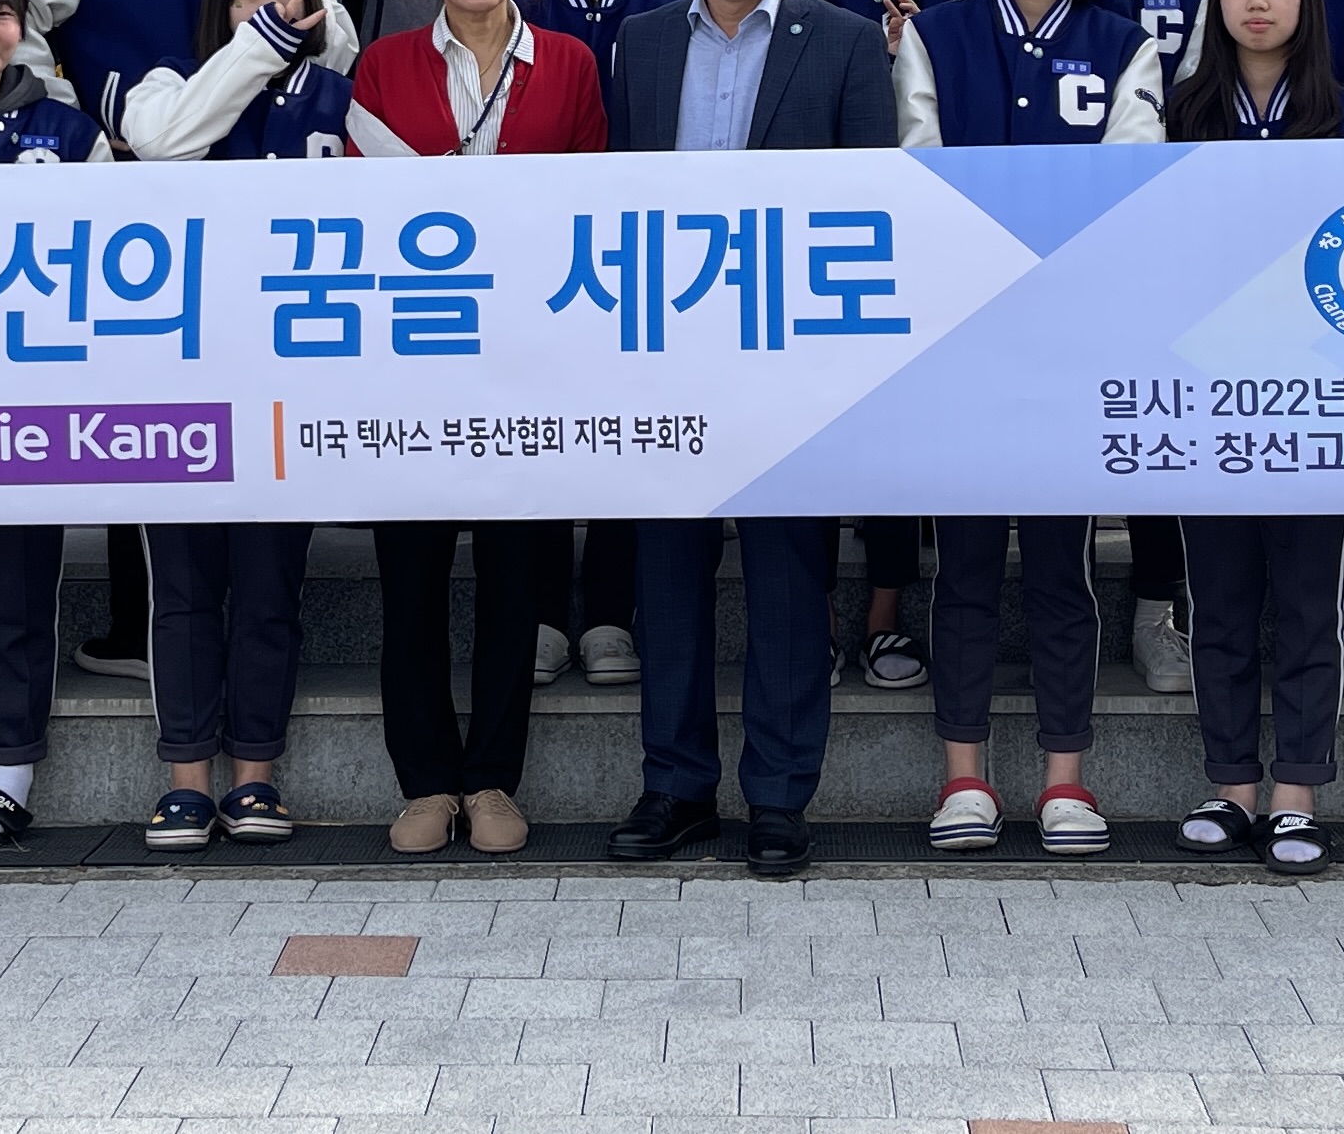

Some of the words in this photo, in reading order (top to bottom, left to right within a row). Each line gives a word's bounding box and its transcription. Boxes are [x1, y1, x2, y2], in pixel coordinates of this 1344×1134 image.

[1058, 73, 1105, 126] C
[261, 211, 494, 357] 꿈을
[545, 207, 911, 353] 세계로
[1100, 378, 1195, 419] 일시:
[69, 413, 217, 473] Kang
[299, 420, 348, 458] 미국
[357, 418, 432, 458] 텍사스
[440, 416, 564, 458] 부동산협회
[574, 416, 622, 456] 지역
[631, 414, 708, 455] 부회장
[1100, 432, 1197, 474] 장소:
[1280, 816, 1309, 826] NIKE
